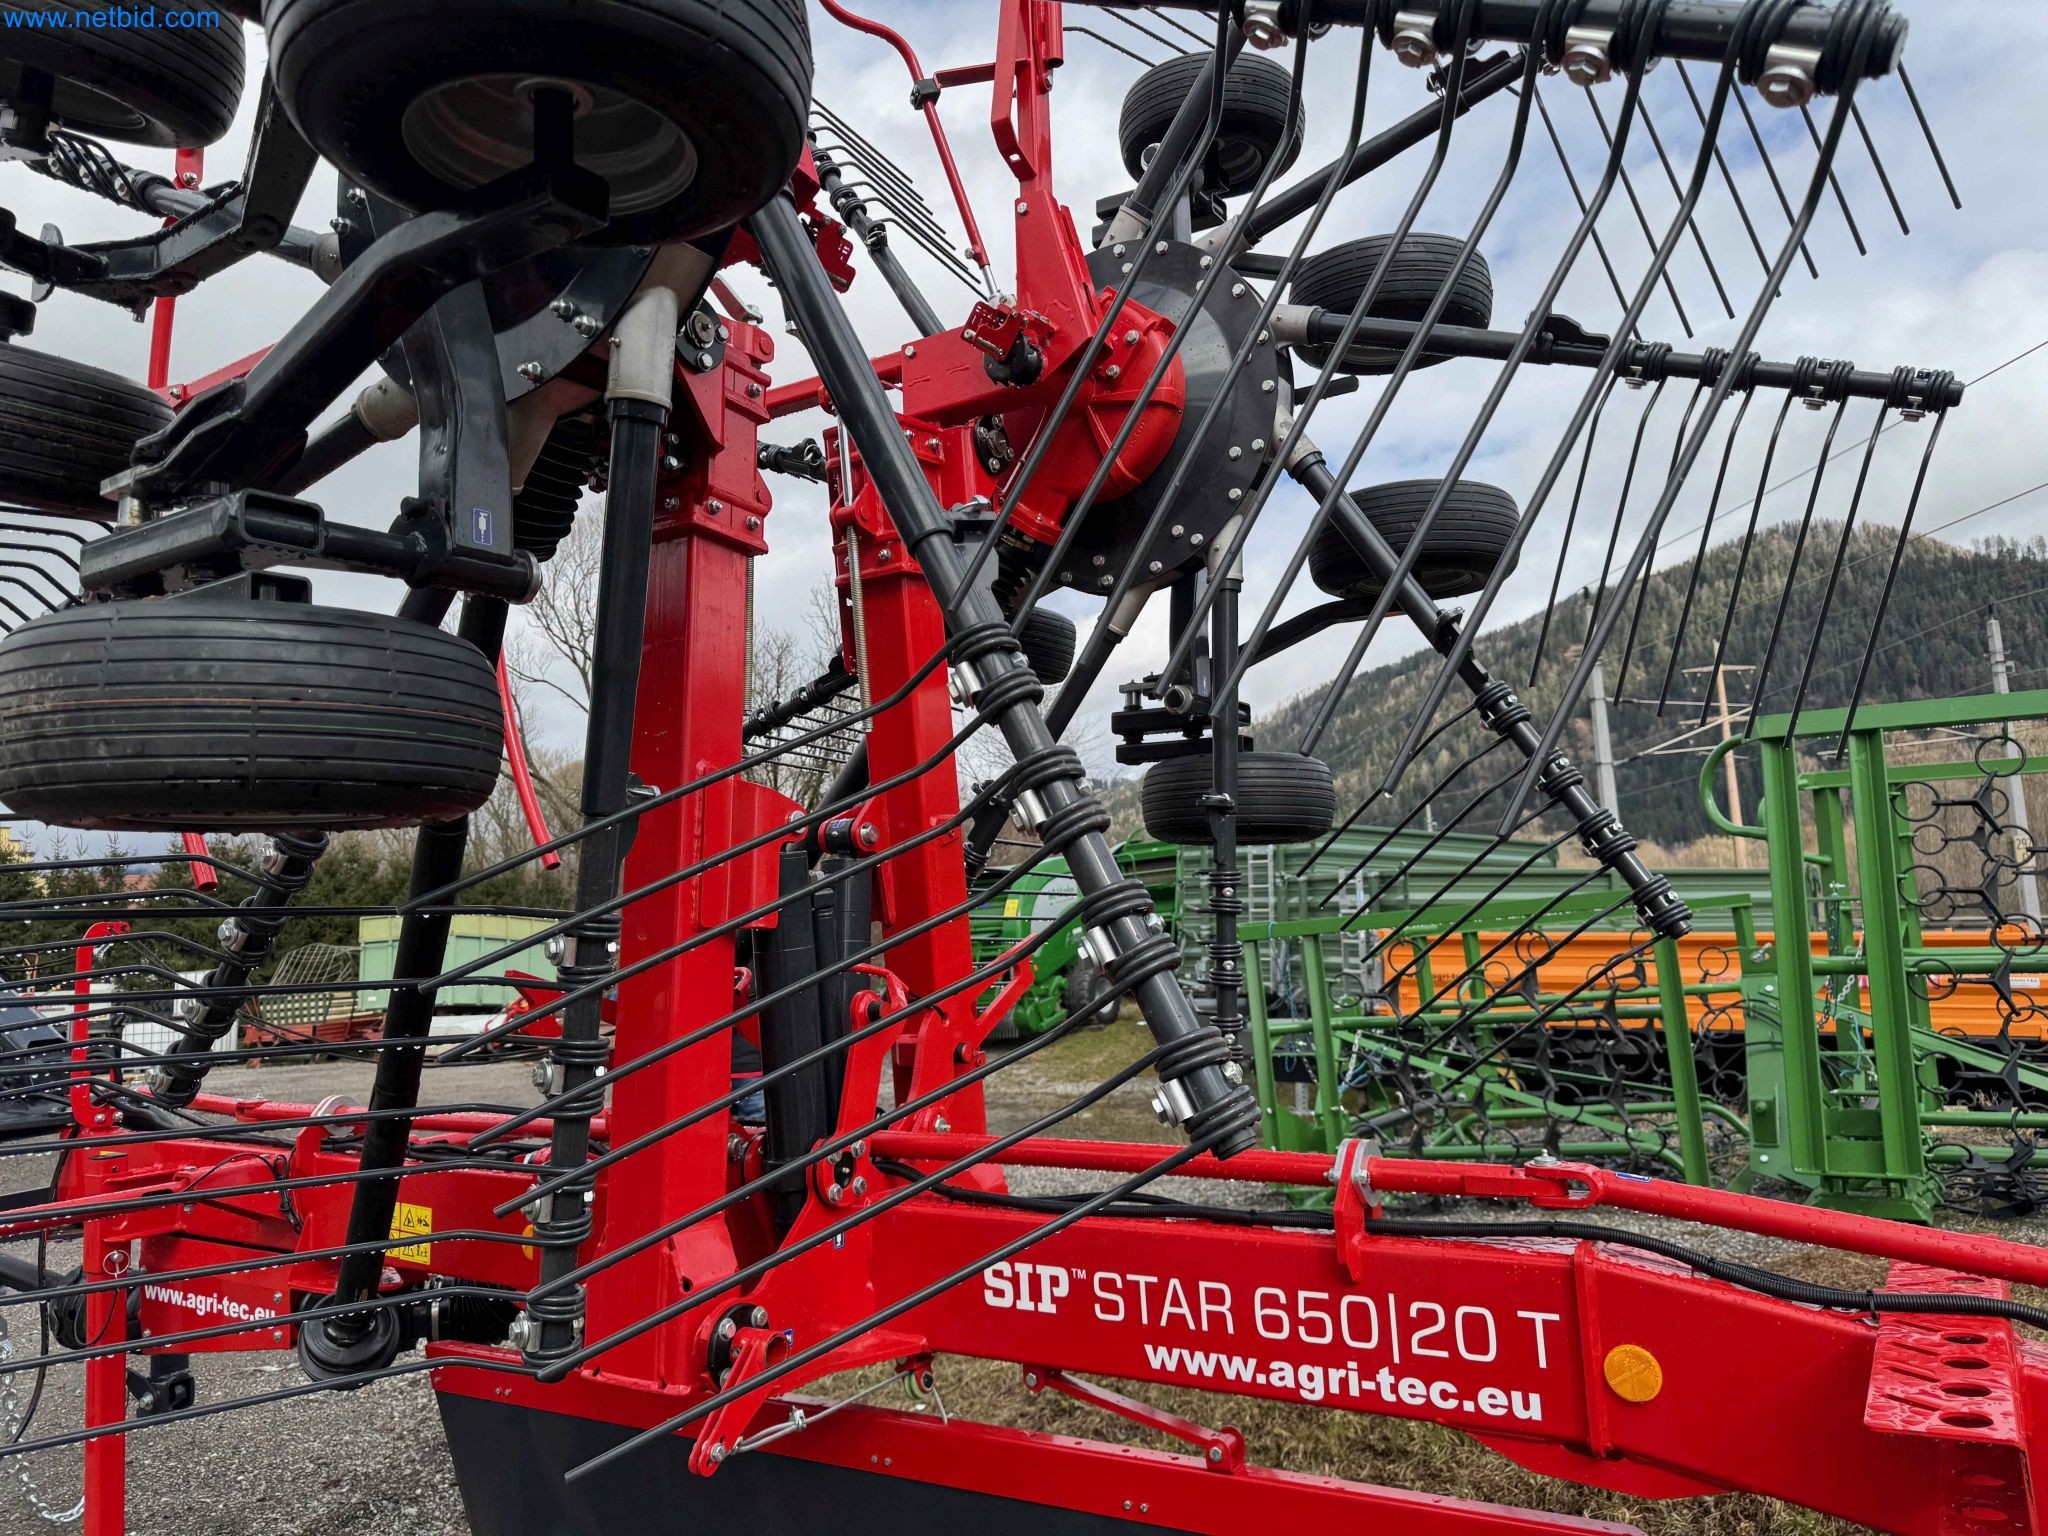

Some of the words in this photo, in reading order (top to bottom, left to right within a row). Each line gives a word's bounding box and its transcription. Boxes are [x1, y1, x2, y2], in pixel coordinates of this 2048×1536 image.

[1093, 1271, 1234, 1334] STAR
[1516, 1310, 1560, 1369] T
[1144, 1344, 1543, 1421] www.agri-tec.eu
